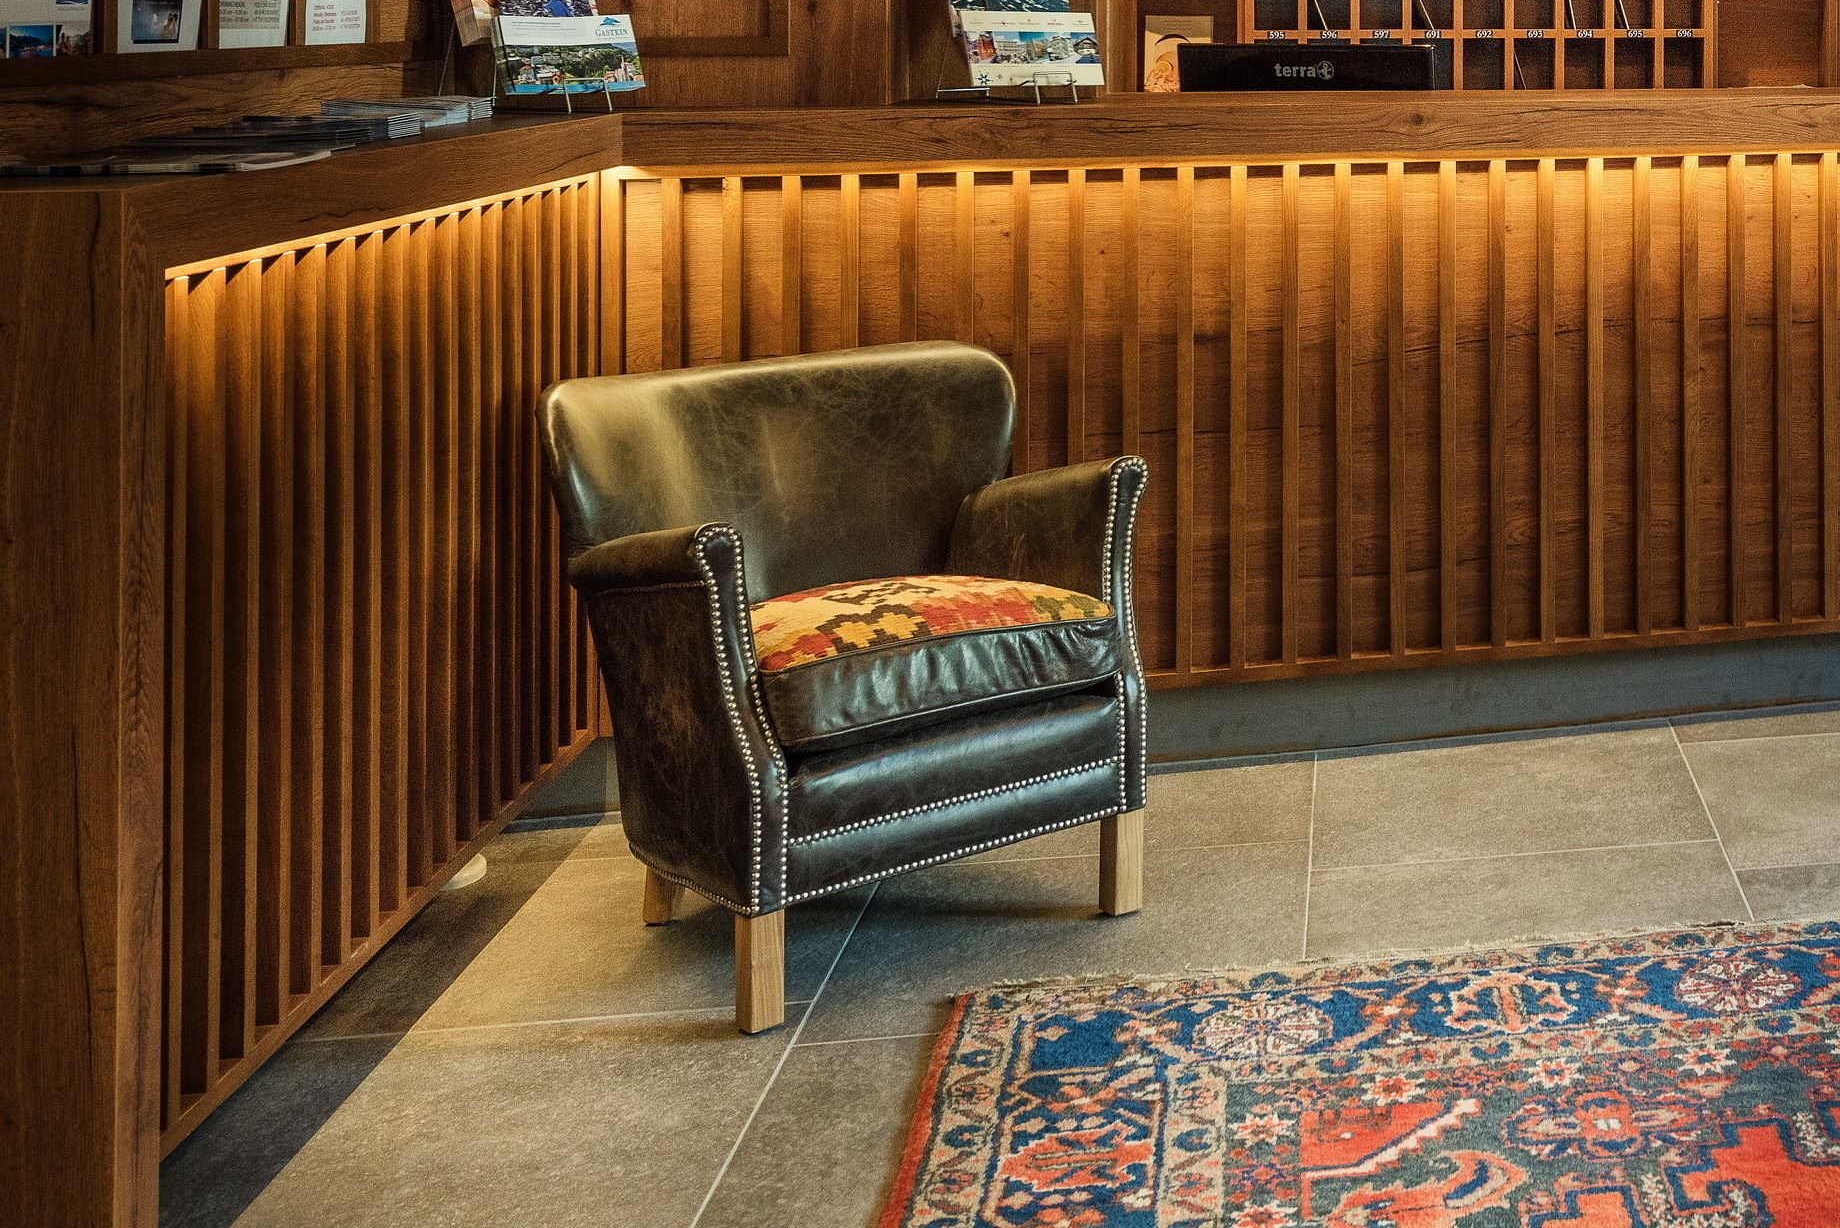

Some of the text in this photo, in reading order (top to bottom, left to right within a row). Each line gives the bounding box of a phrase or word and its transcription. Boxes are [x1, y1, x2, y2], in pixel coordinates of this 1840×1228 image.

[595, 28, 629, 37] GASTEIN
[1268, 30, 1285, 39] 595
[1321, 30, 1337, 39] 596
[1373, 30, 1390, 39] 597
[1425, 30, 1441, 39] 691
[1476, 30, 1492, 39] 692
[1527, 30, 1543, 39] 693
[1577, 30, 1593, 39] 694
[1627, 30, 1643, 39] 695
[1677, 30, 1693, 39] 696
[1274, 63, 1317, 78] terra
